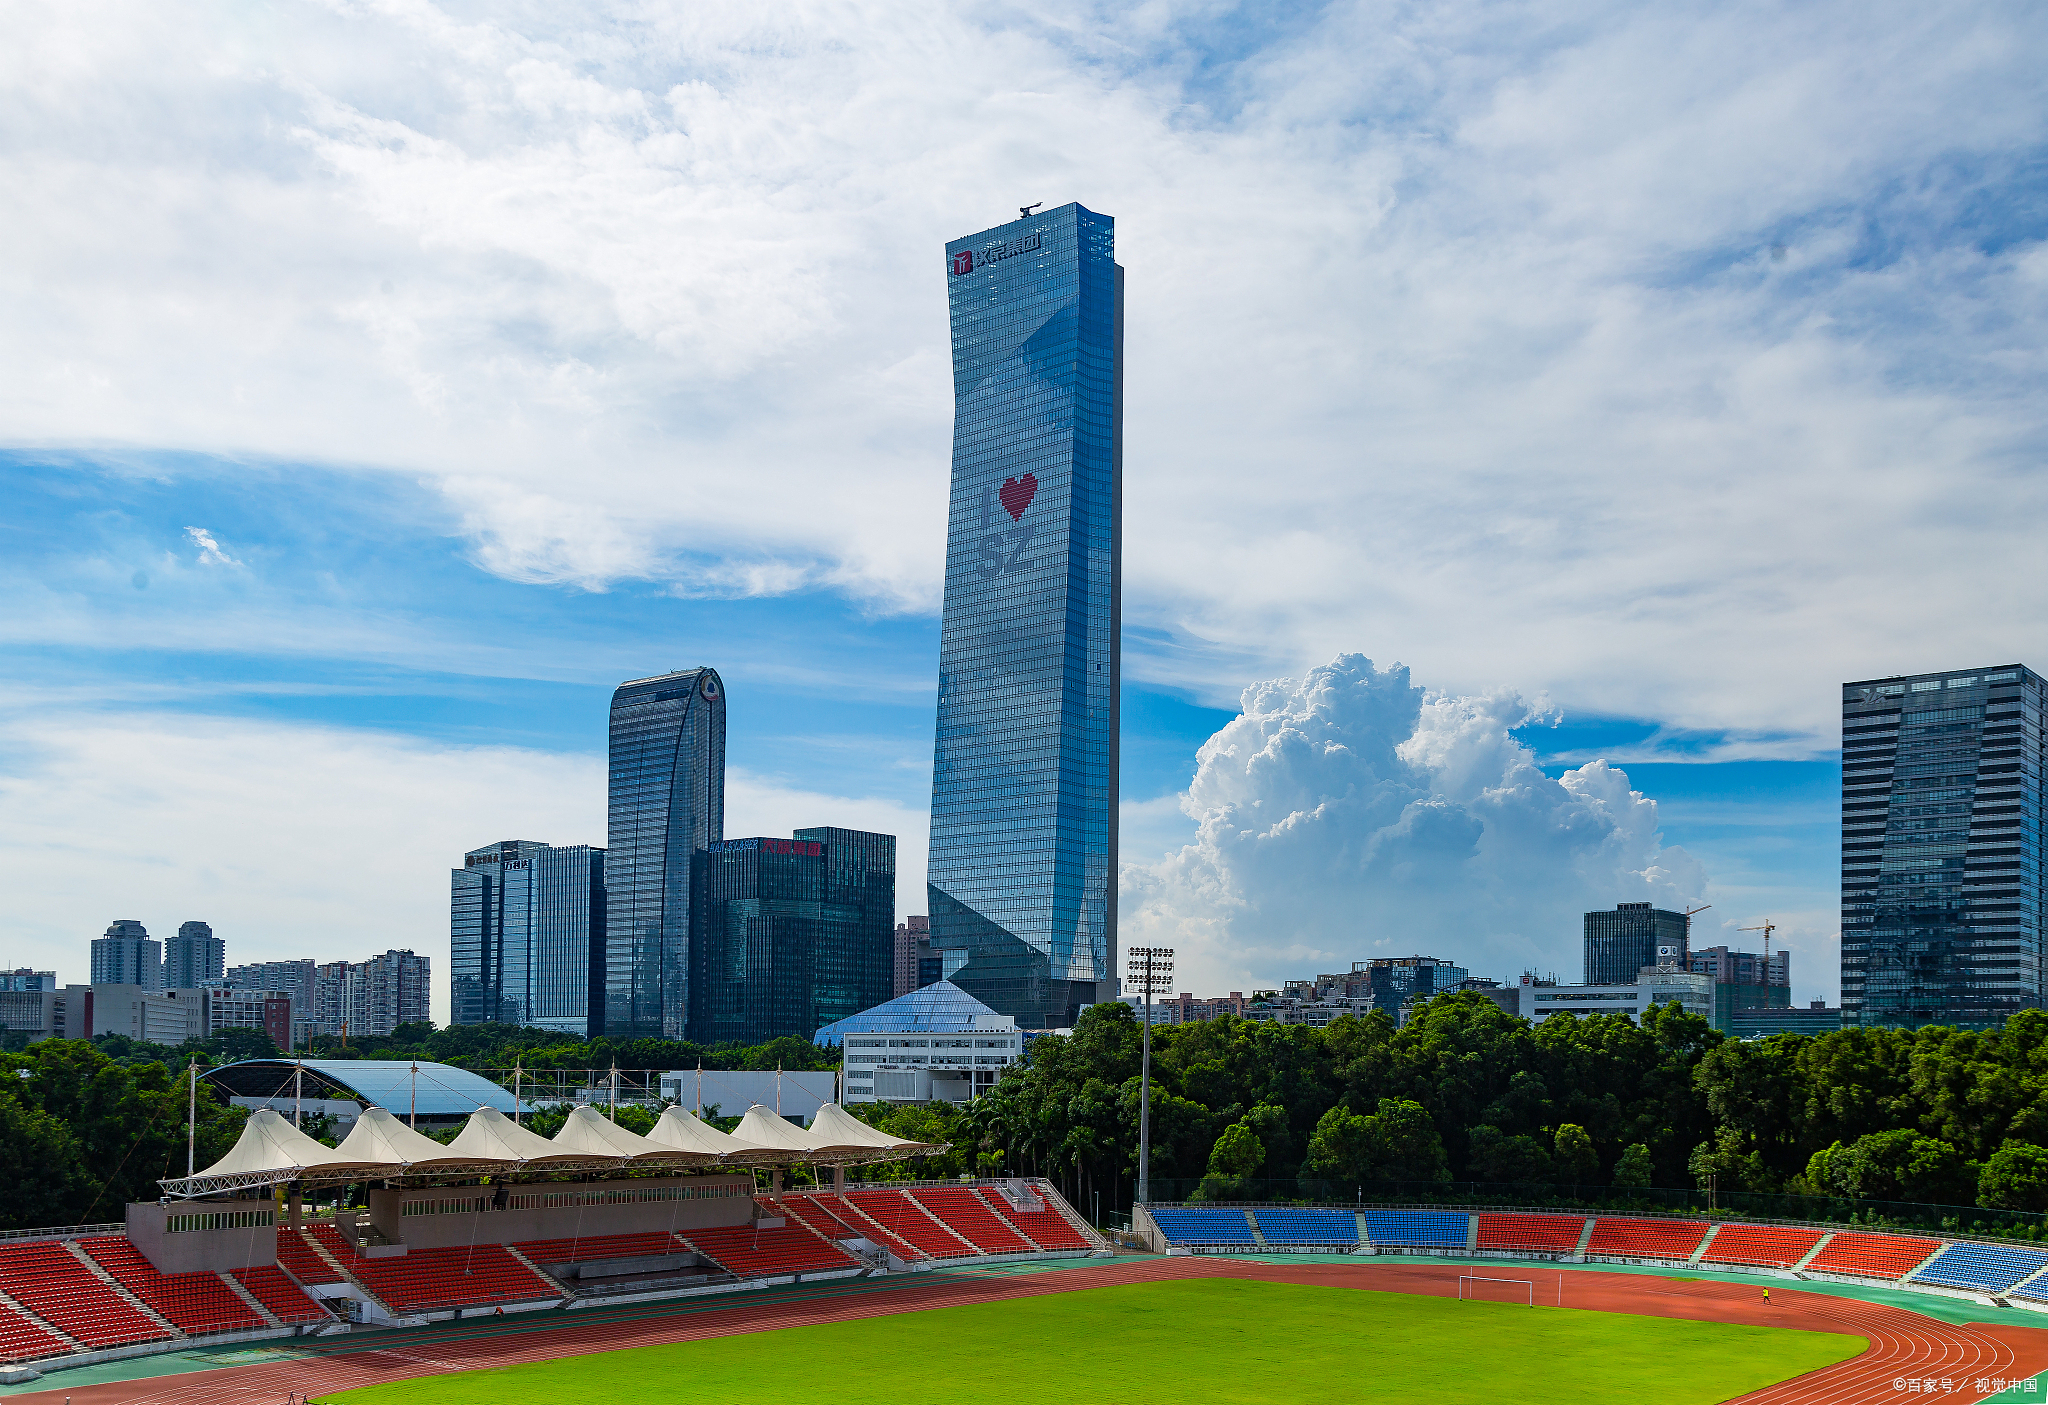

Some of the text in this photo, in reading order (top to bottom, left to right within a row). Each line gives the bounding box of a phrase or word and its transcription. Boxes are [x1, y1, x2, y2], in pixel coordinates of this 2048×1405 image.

[976, 524, 1036, 578] SZ
[760, 840, 821, 857] 大族集团
